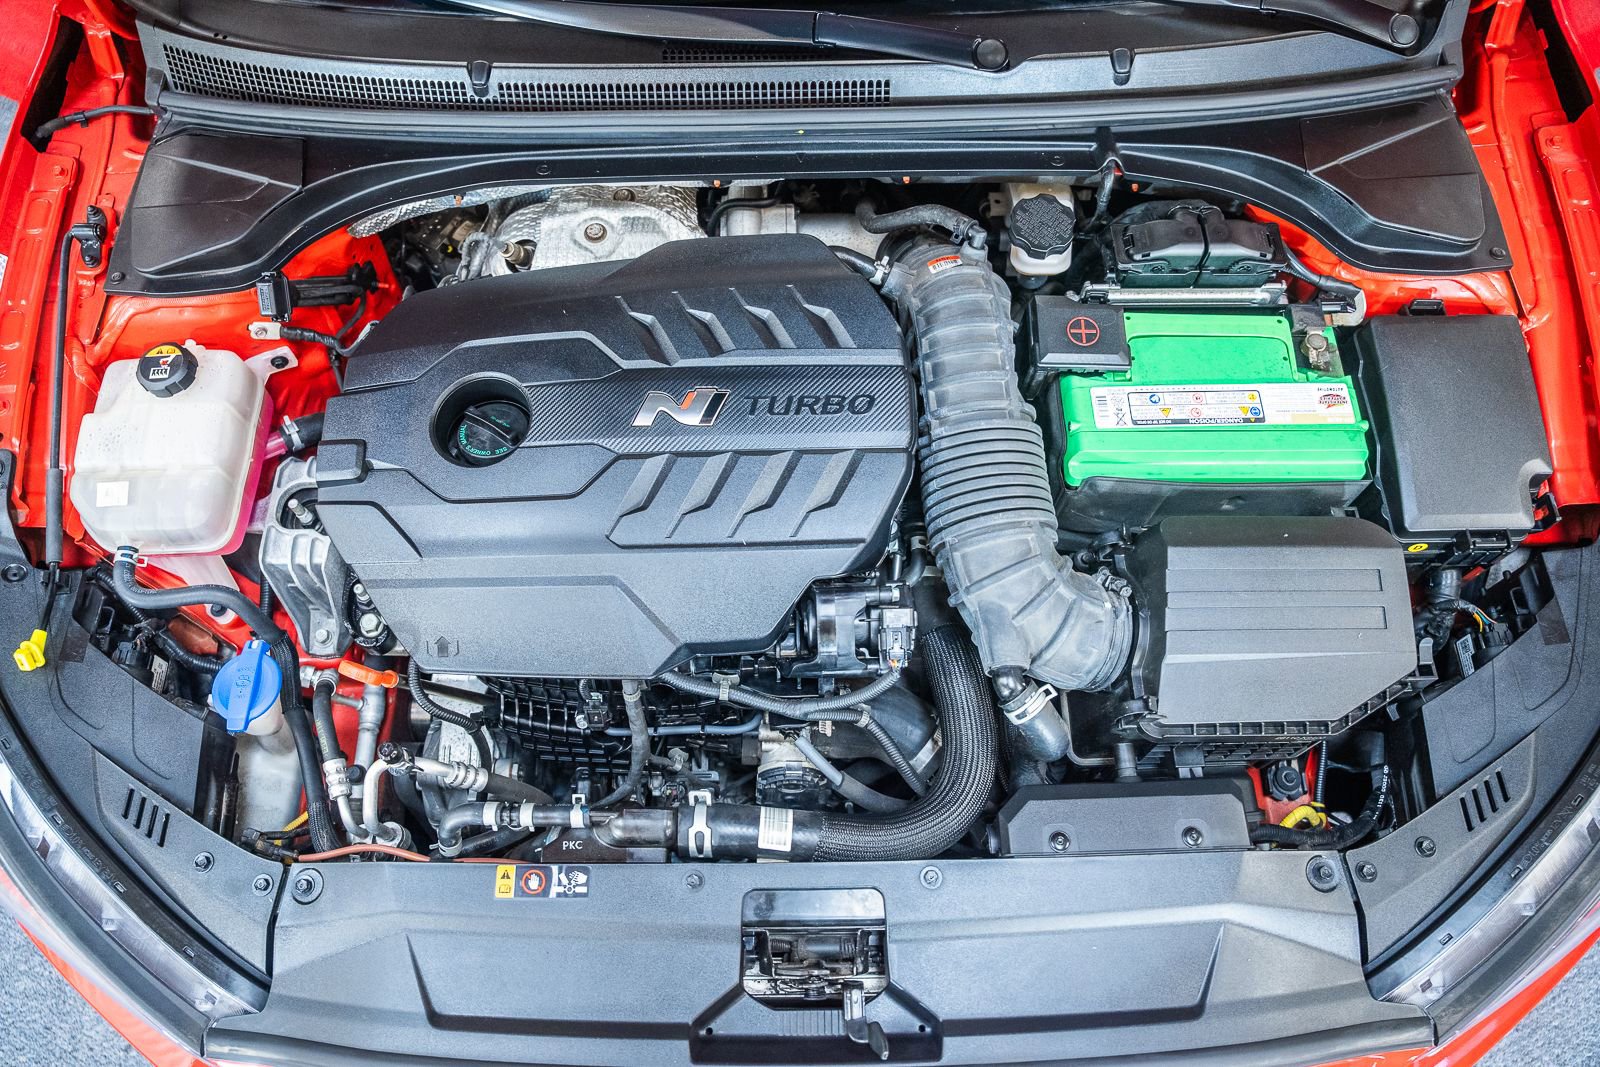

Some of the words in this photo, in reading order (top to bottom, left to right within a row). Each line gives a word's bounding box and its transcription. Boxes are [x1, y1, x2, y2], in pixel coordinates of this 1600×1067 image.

[743, 393, 877, 416] TURBO
[458, 424, 467, 445] MANUAL
[465, 444, 491, 456] OWNER'S
[494, 446, 508, 455] SEE
[562, 840, 583, 851] PKC
